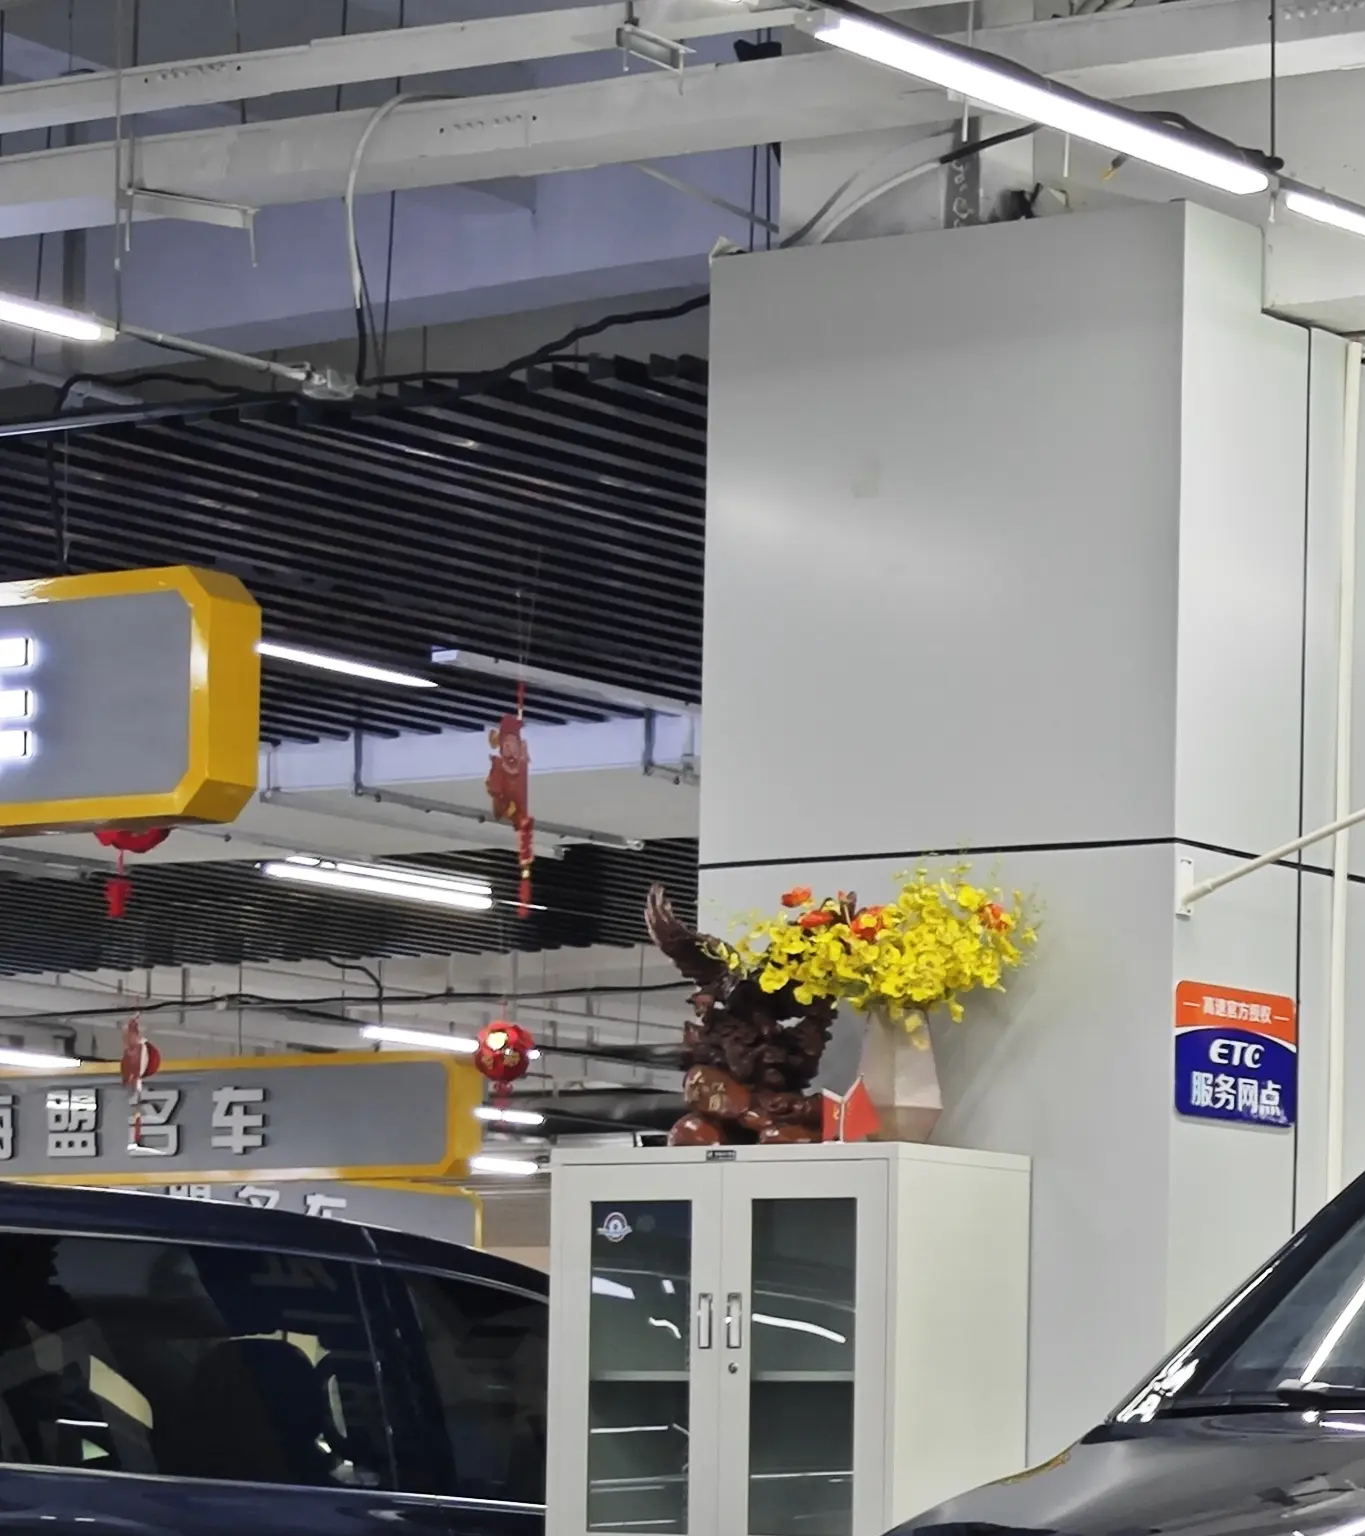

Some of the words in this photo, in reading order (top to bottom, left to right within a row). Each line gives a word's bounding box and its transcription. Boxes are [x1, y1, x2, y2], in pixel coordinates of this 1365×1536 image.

[1209, 1039, 1265, 1068] ETC
[1191, 1071, 1282, 1117] 服务网点
